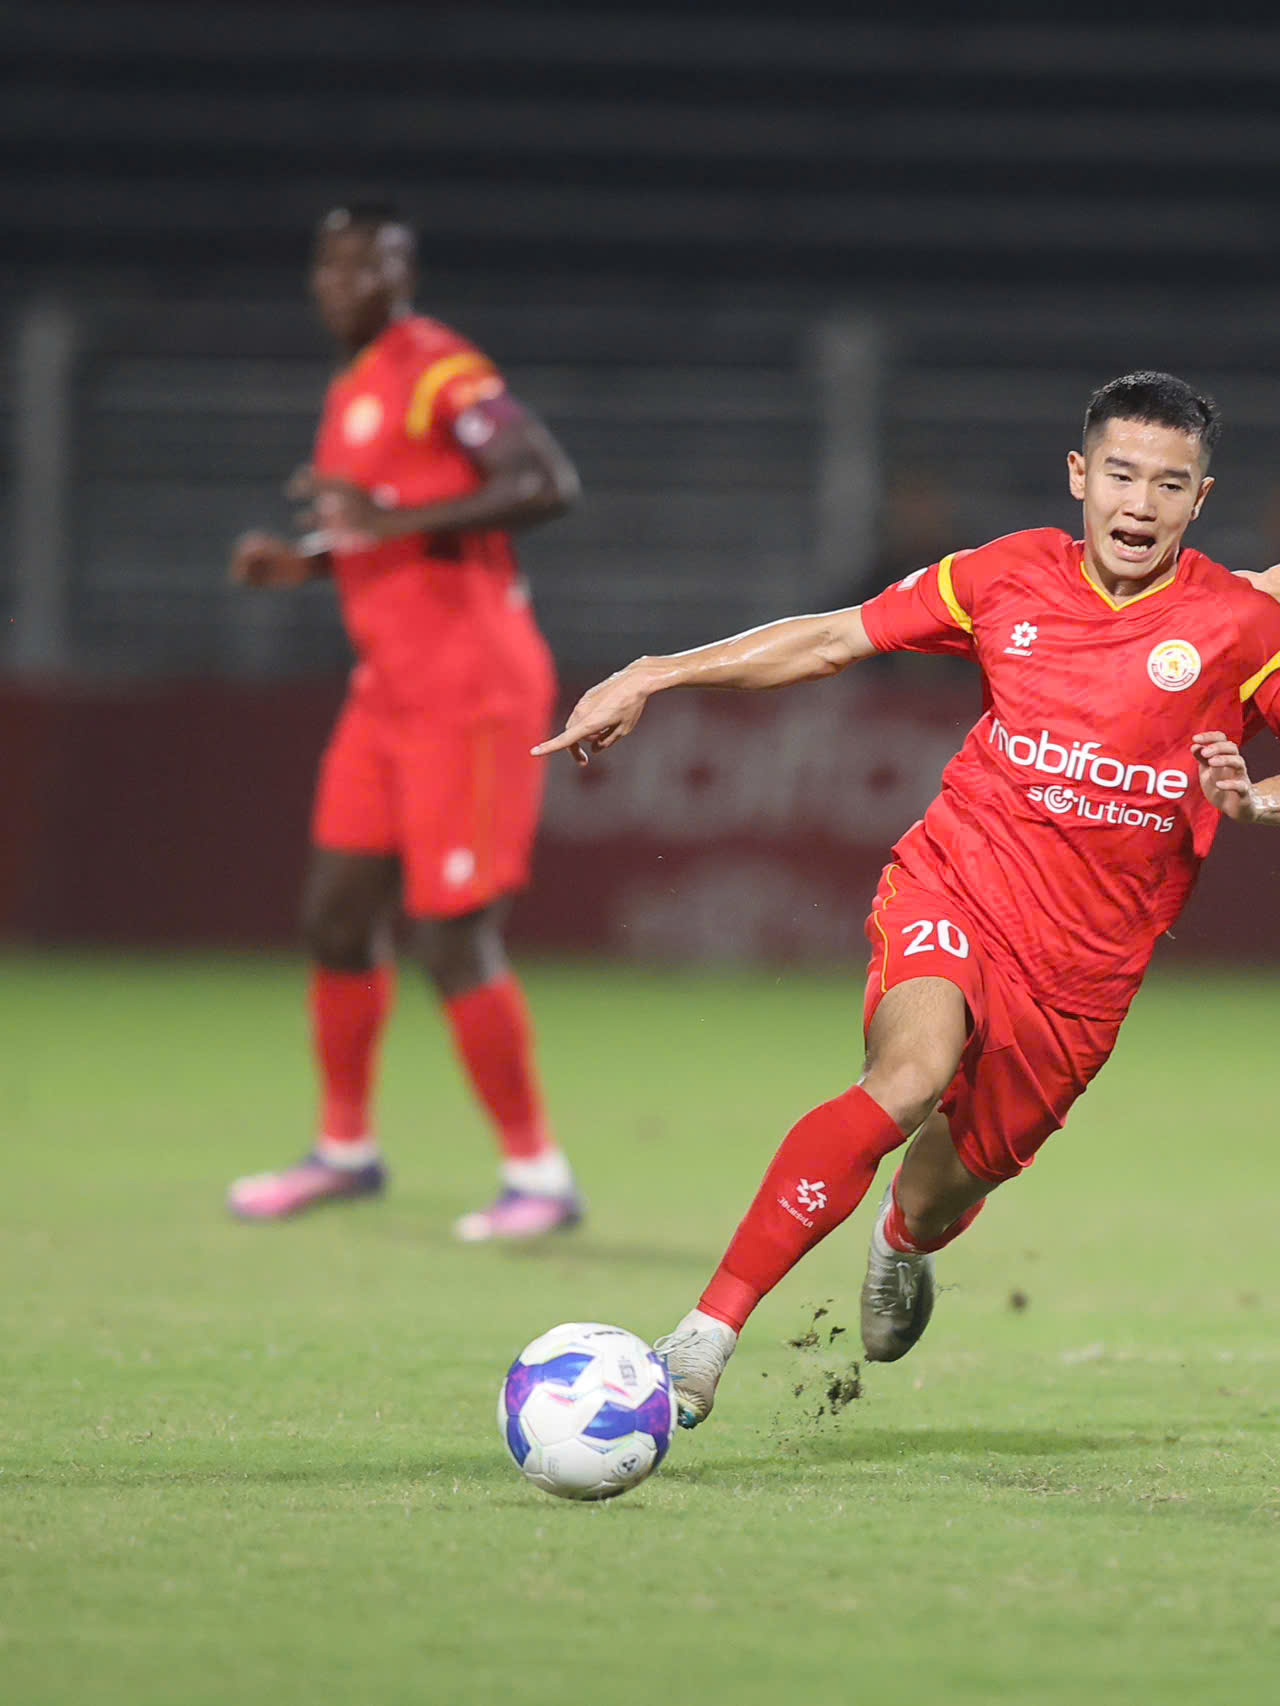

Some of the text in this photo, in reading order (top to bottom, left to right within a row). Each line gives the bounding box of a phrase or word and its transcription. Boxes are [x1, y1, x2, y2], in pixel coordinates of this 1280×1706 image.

[989, 718, 1188, 799] mobifone
[1027, 785, 1176, 832] solutions
[901, 919, 969, 959] 20
